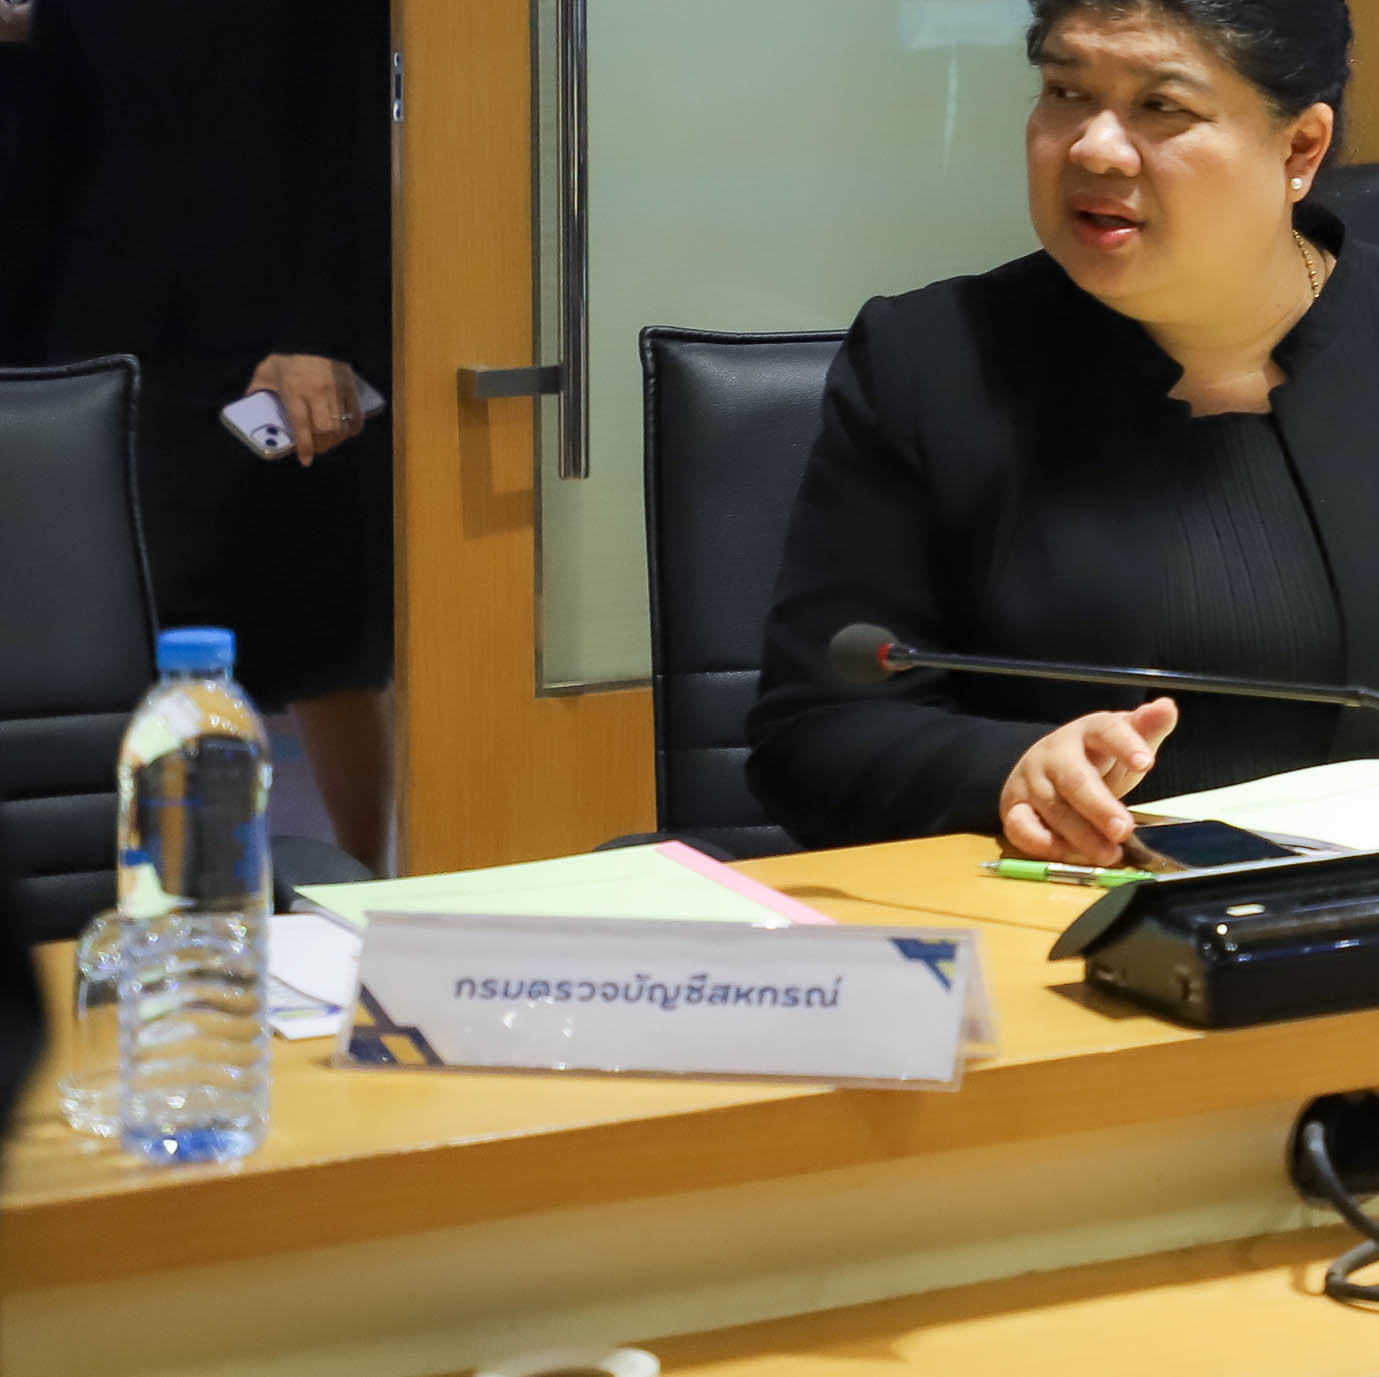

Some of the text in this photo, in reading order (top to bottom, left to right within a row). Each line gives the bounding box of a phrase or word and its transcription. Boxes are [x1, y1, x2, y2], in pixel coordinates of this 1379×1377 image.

[453, 971, 845, 1011] กรมตรวจบัญชีสหกรณ์
